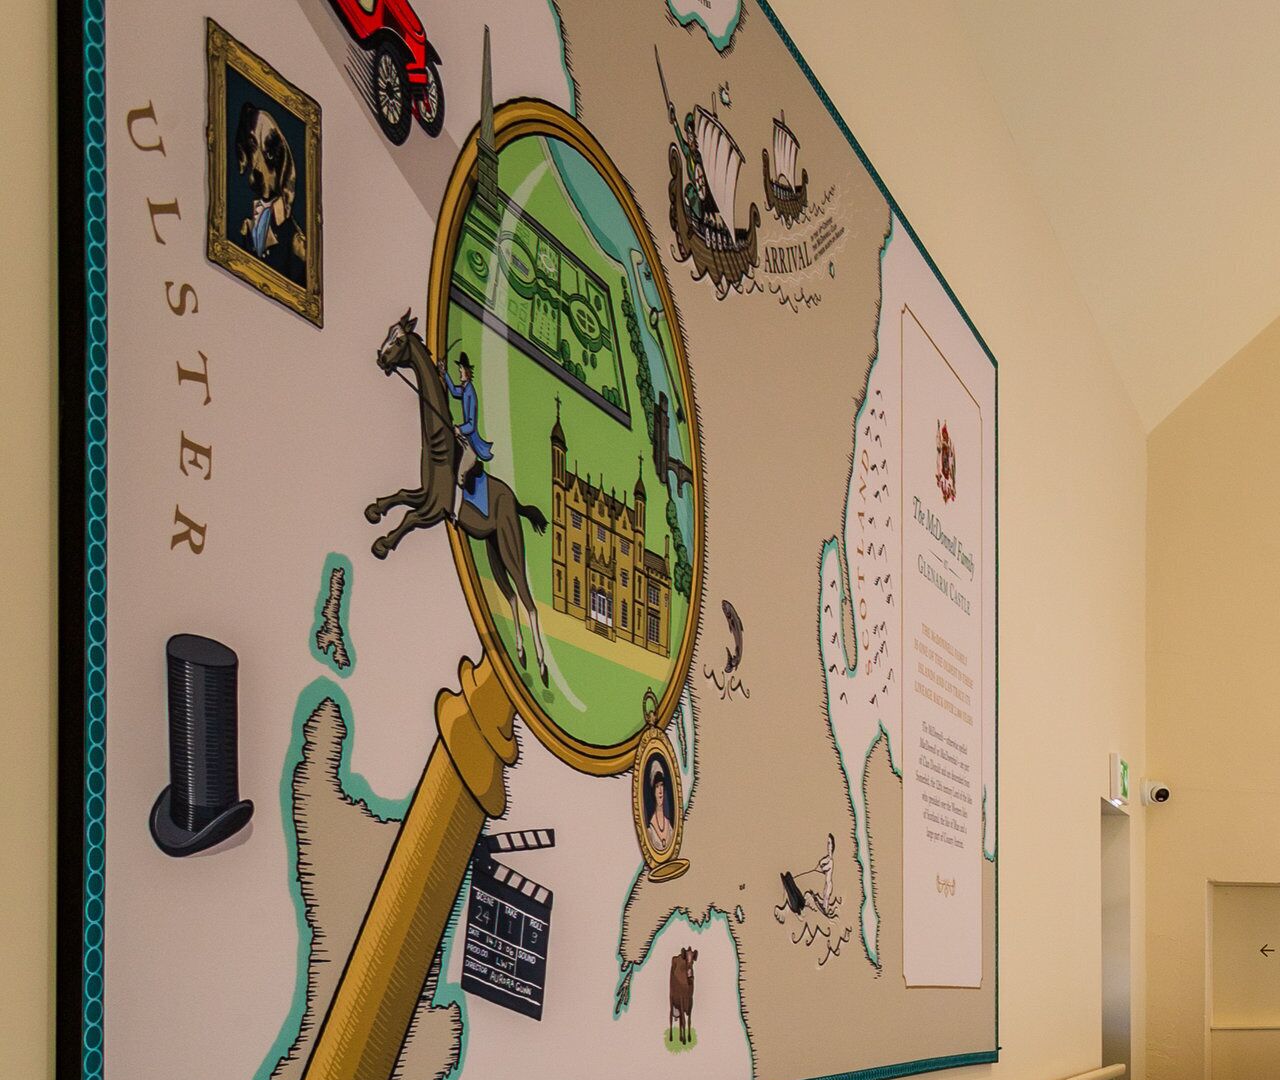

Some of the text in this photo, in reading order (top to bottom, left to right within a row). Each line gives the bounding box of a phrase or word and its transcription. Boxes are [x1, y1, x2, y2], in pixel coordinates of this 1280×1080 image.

[765, 241, 812, 274] ARRIVAL
[126, 99, 213, 555] ULSTER
[913, 495, 975, 582] The McDonnell Family
[856, 449, 873, 676] SCOTLAND
[475, 891, 544, 932] SCENE TAKE ROLL
[475, 904, 491, 925] 24
[465, 959, 489, 975] DIRECTOR
[517, 950, 537, 965] SOUND
